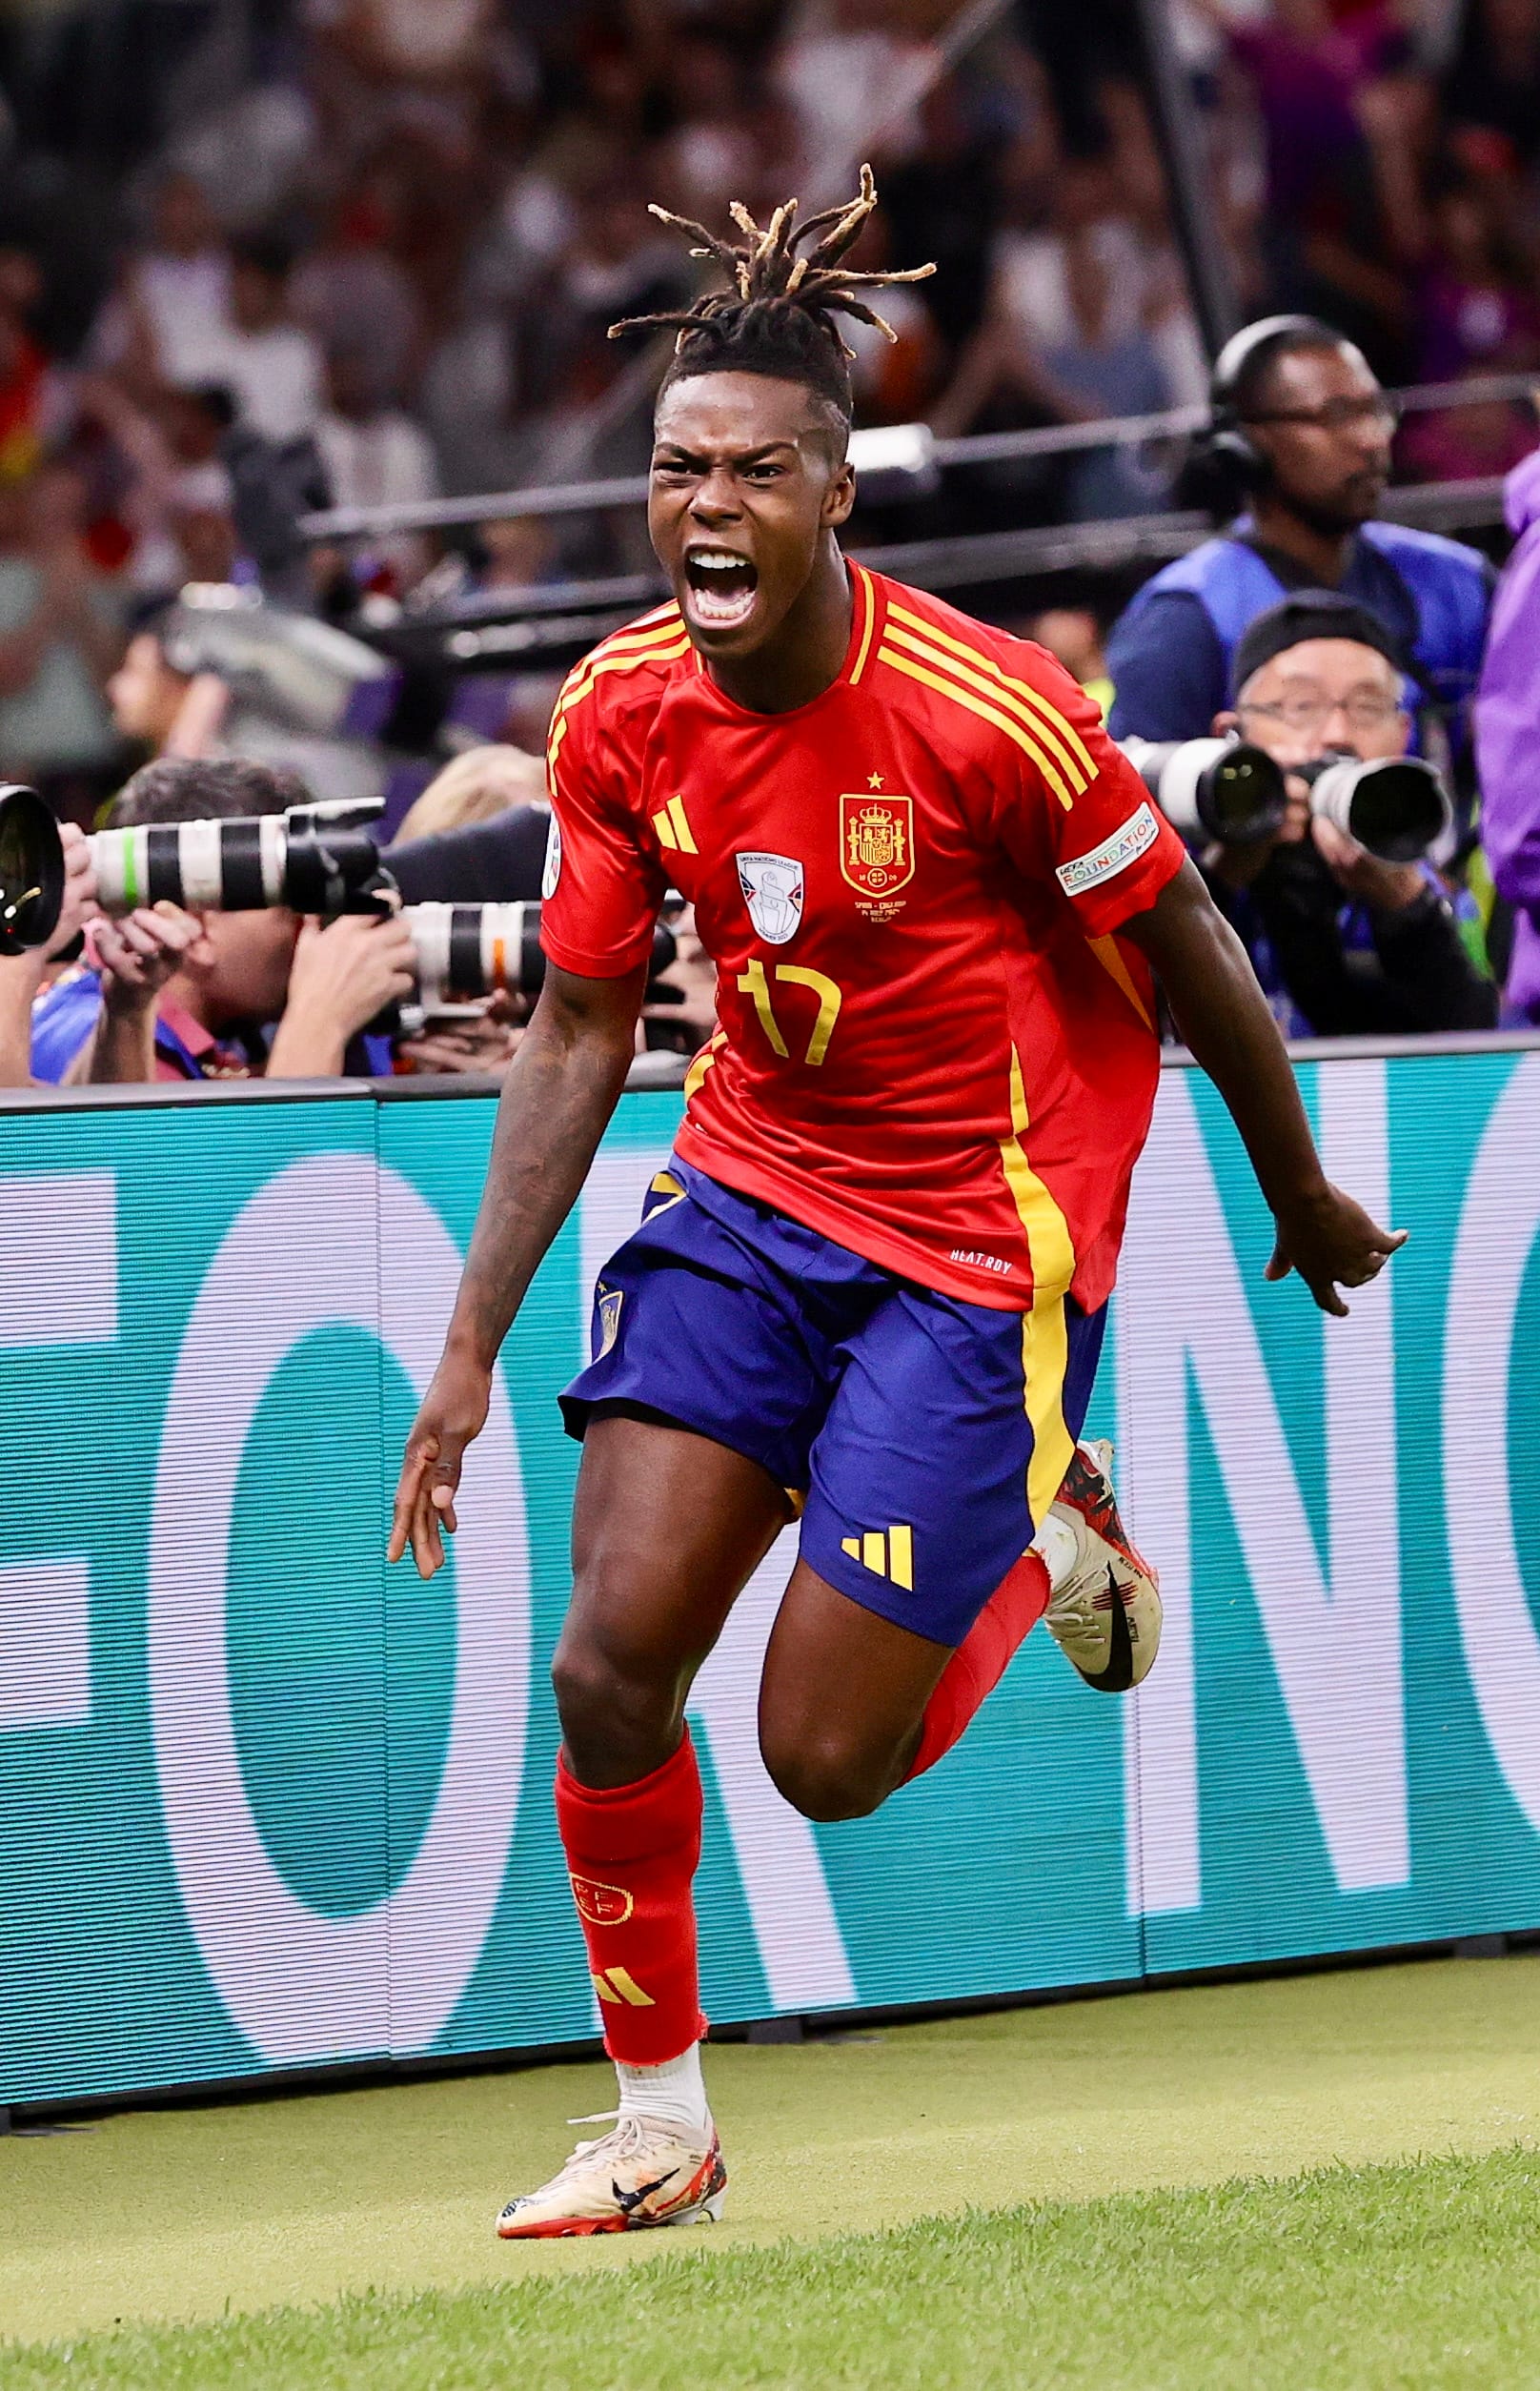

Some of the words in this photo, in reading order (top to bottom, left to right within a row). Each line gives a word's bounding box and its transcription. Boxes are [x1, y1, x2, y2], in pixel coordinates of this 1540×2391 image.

[1060, 861, 1084, 876] UEFA
[1064, 815, 1152, 886] FOUNDATION
[737, 958, 842, 1065] 17
[950, 1249, 1012, 1275] HEAT.RDY
